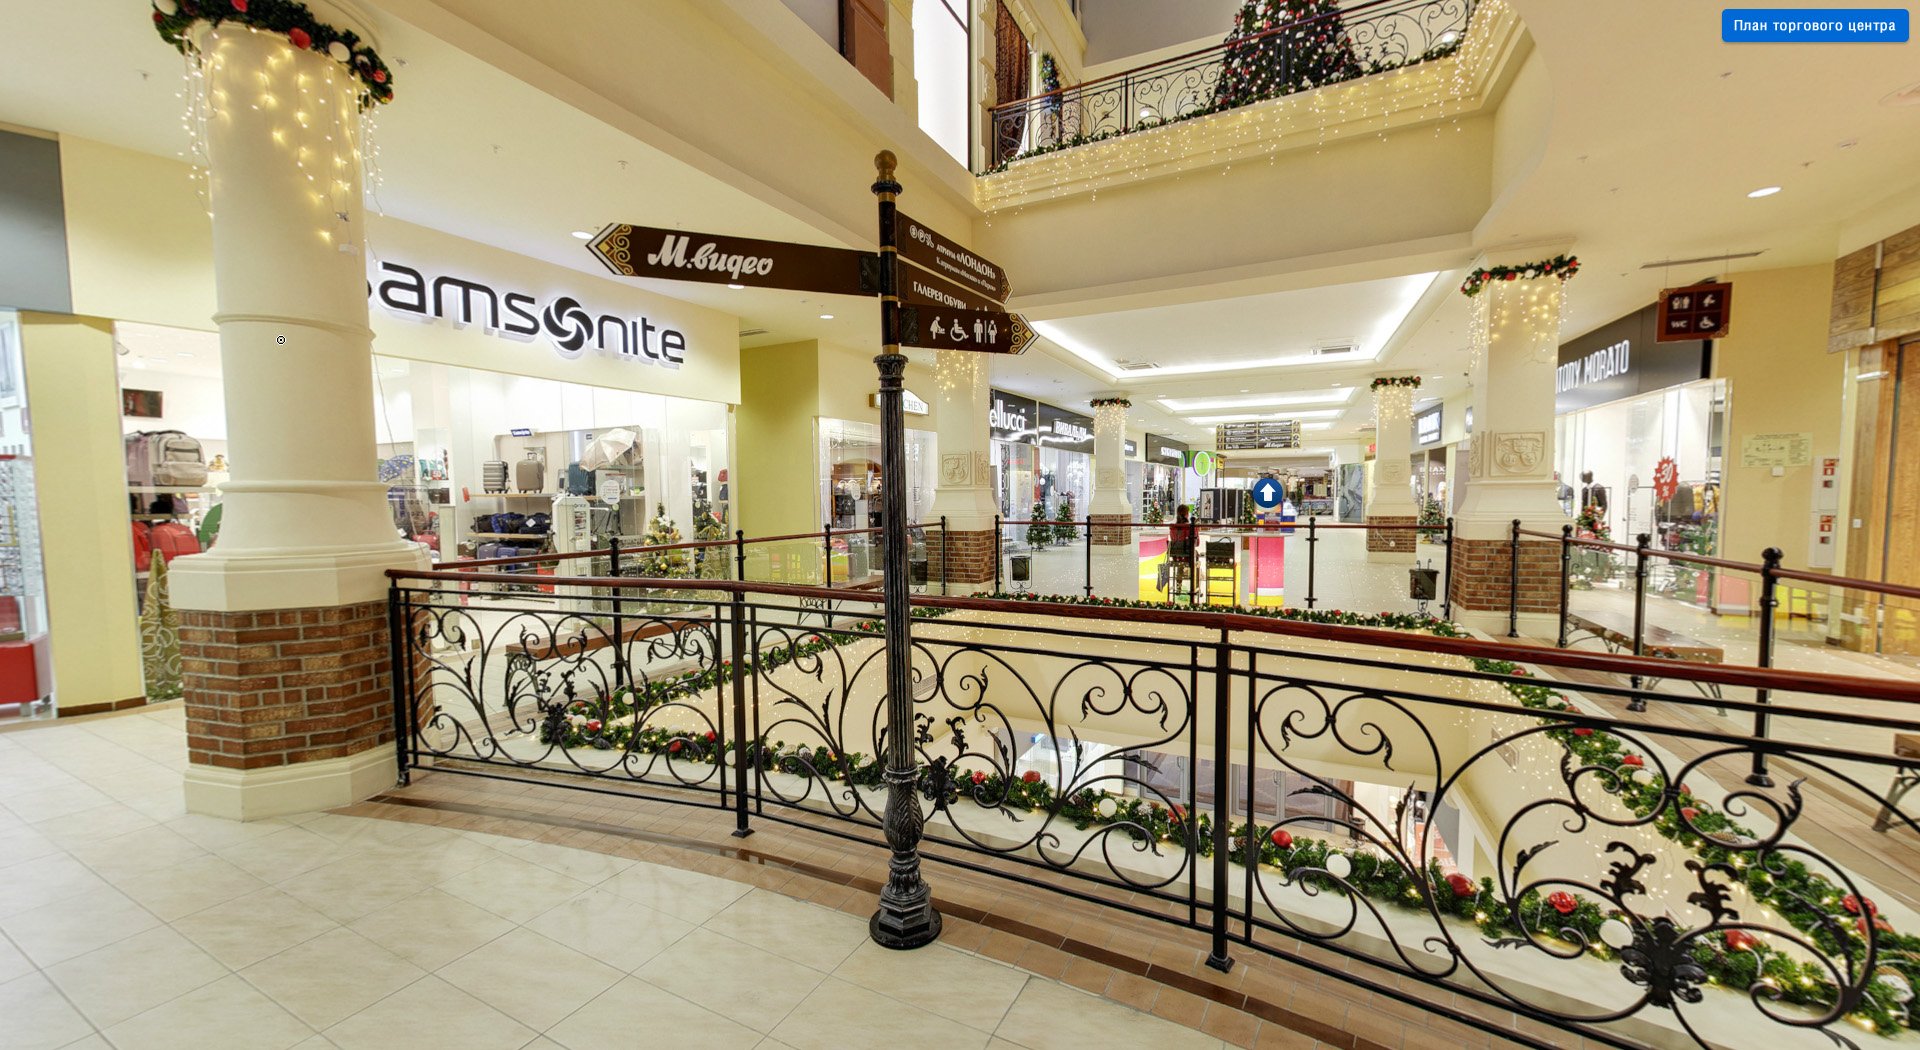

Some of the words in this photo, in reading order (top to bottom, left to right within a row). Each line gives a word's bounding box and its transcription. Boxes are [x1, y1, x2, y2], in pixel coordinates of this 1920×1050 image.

[648, 234, 773, 280] М.видео
[957, 253, 996, 280] «ЛОНДОН»
[913, 281, 943, 302] ГАЛЕРЕЯ
[943, 294, 967, 310] ОБУВИ
[1671, 320, 1688, 329] WC
[1555, 359, 1582, 395] TONY
[1583, 339, 1630, 386] MORATO
[989, 399, 1026, 432] ellucci
[1656, 462, 1674, 483] -30
